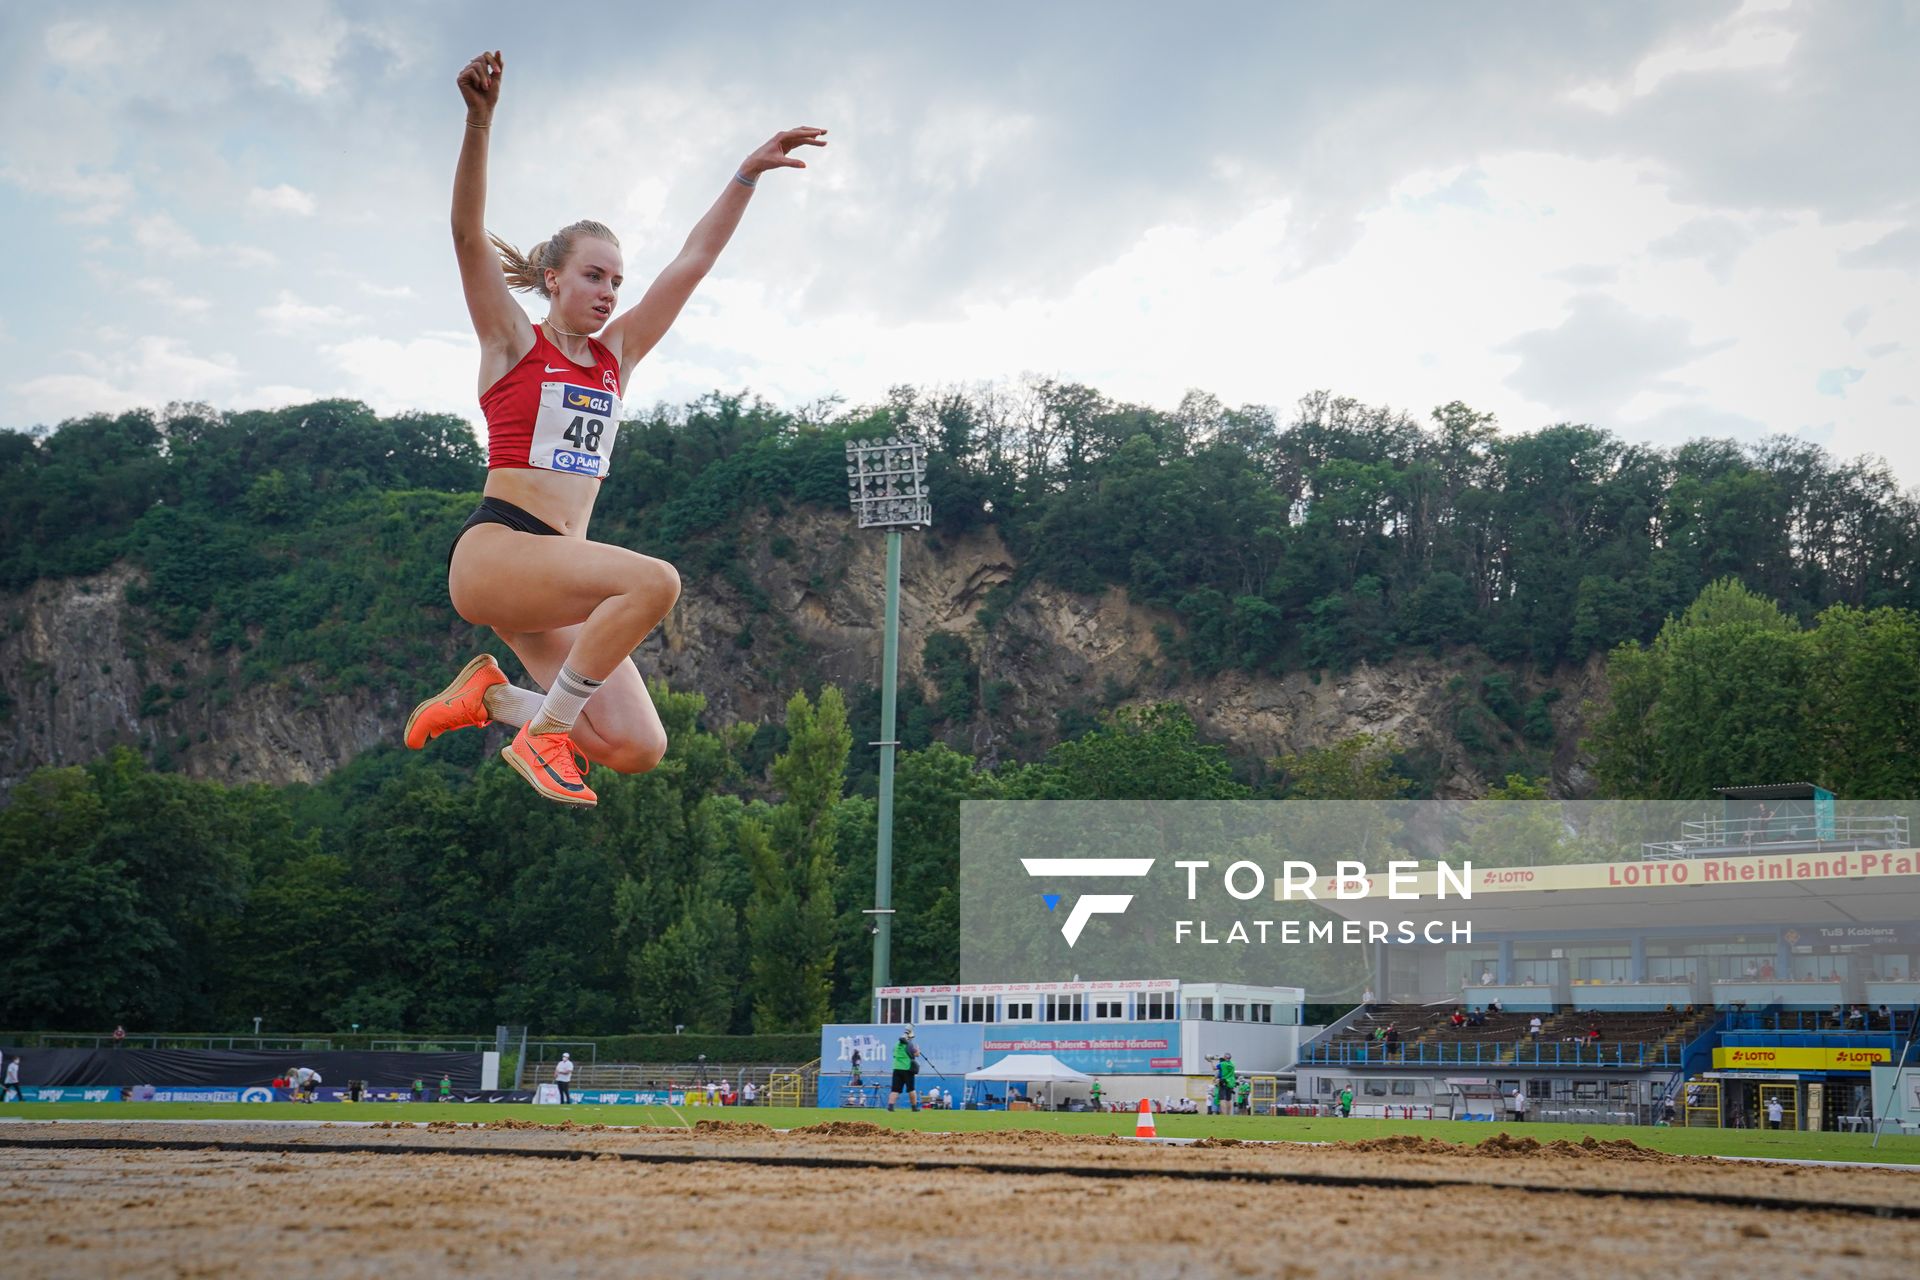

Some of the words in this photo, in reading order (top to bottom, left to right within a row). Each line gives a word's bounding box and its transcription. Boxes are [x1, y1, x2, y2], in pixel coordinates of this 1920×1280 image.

[590, 398, 609, 411] GLS
[563, 415, 604, 452] 48
[576, 456, 599, 469] PLAN
[1498, 870, 1534, 883] LOTTO
[1609, 862, 1689, 886] LOTTO
[1847, 927, 1895, 938] Koblenz
[984, 1041, 1012, 1049] Unser
[1013, 1040, 1052, 1051] größtes
[1089, 1040, 1124, 1049] Talente
[1745, 1052, 1776, 1060] LOTTO
[1850, 1052, 1882, 1062] LOTTO
